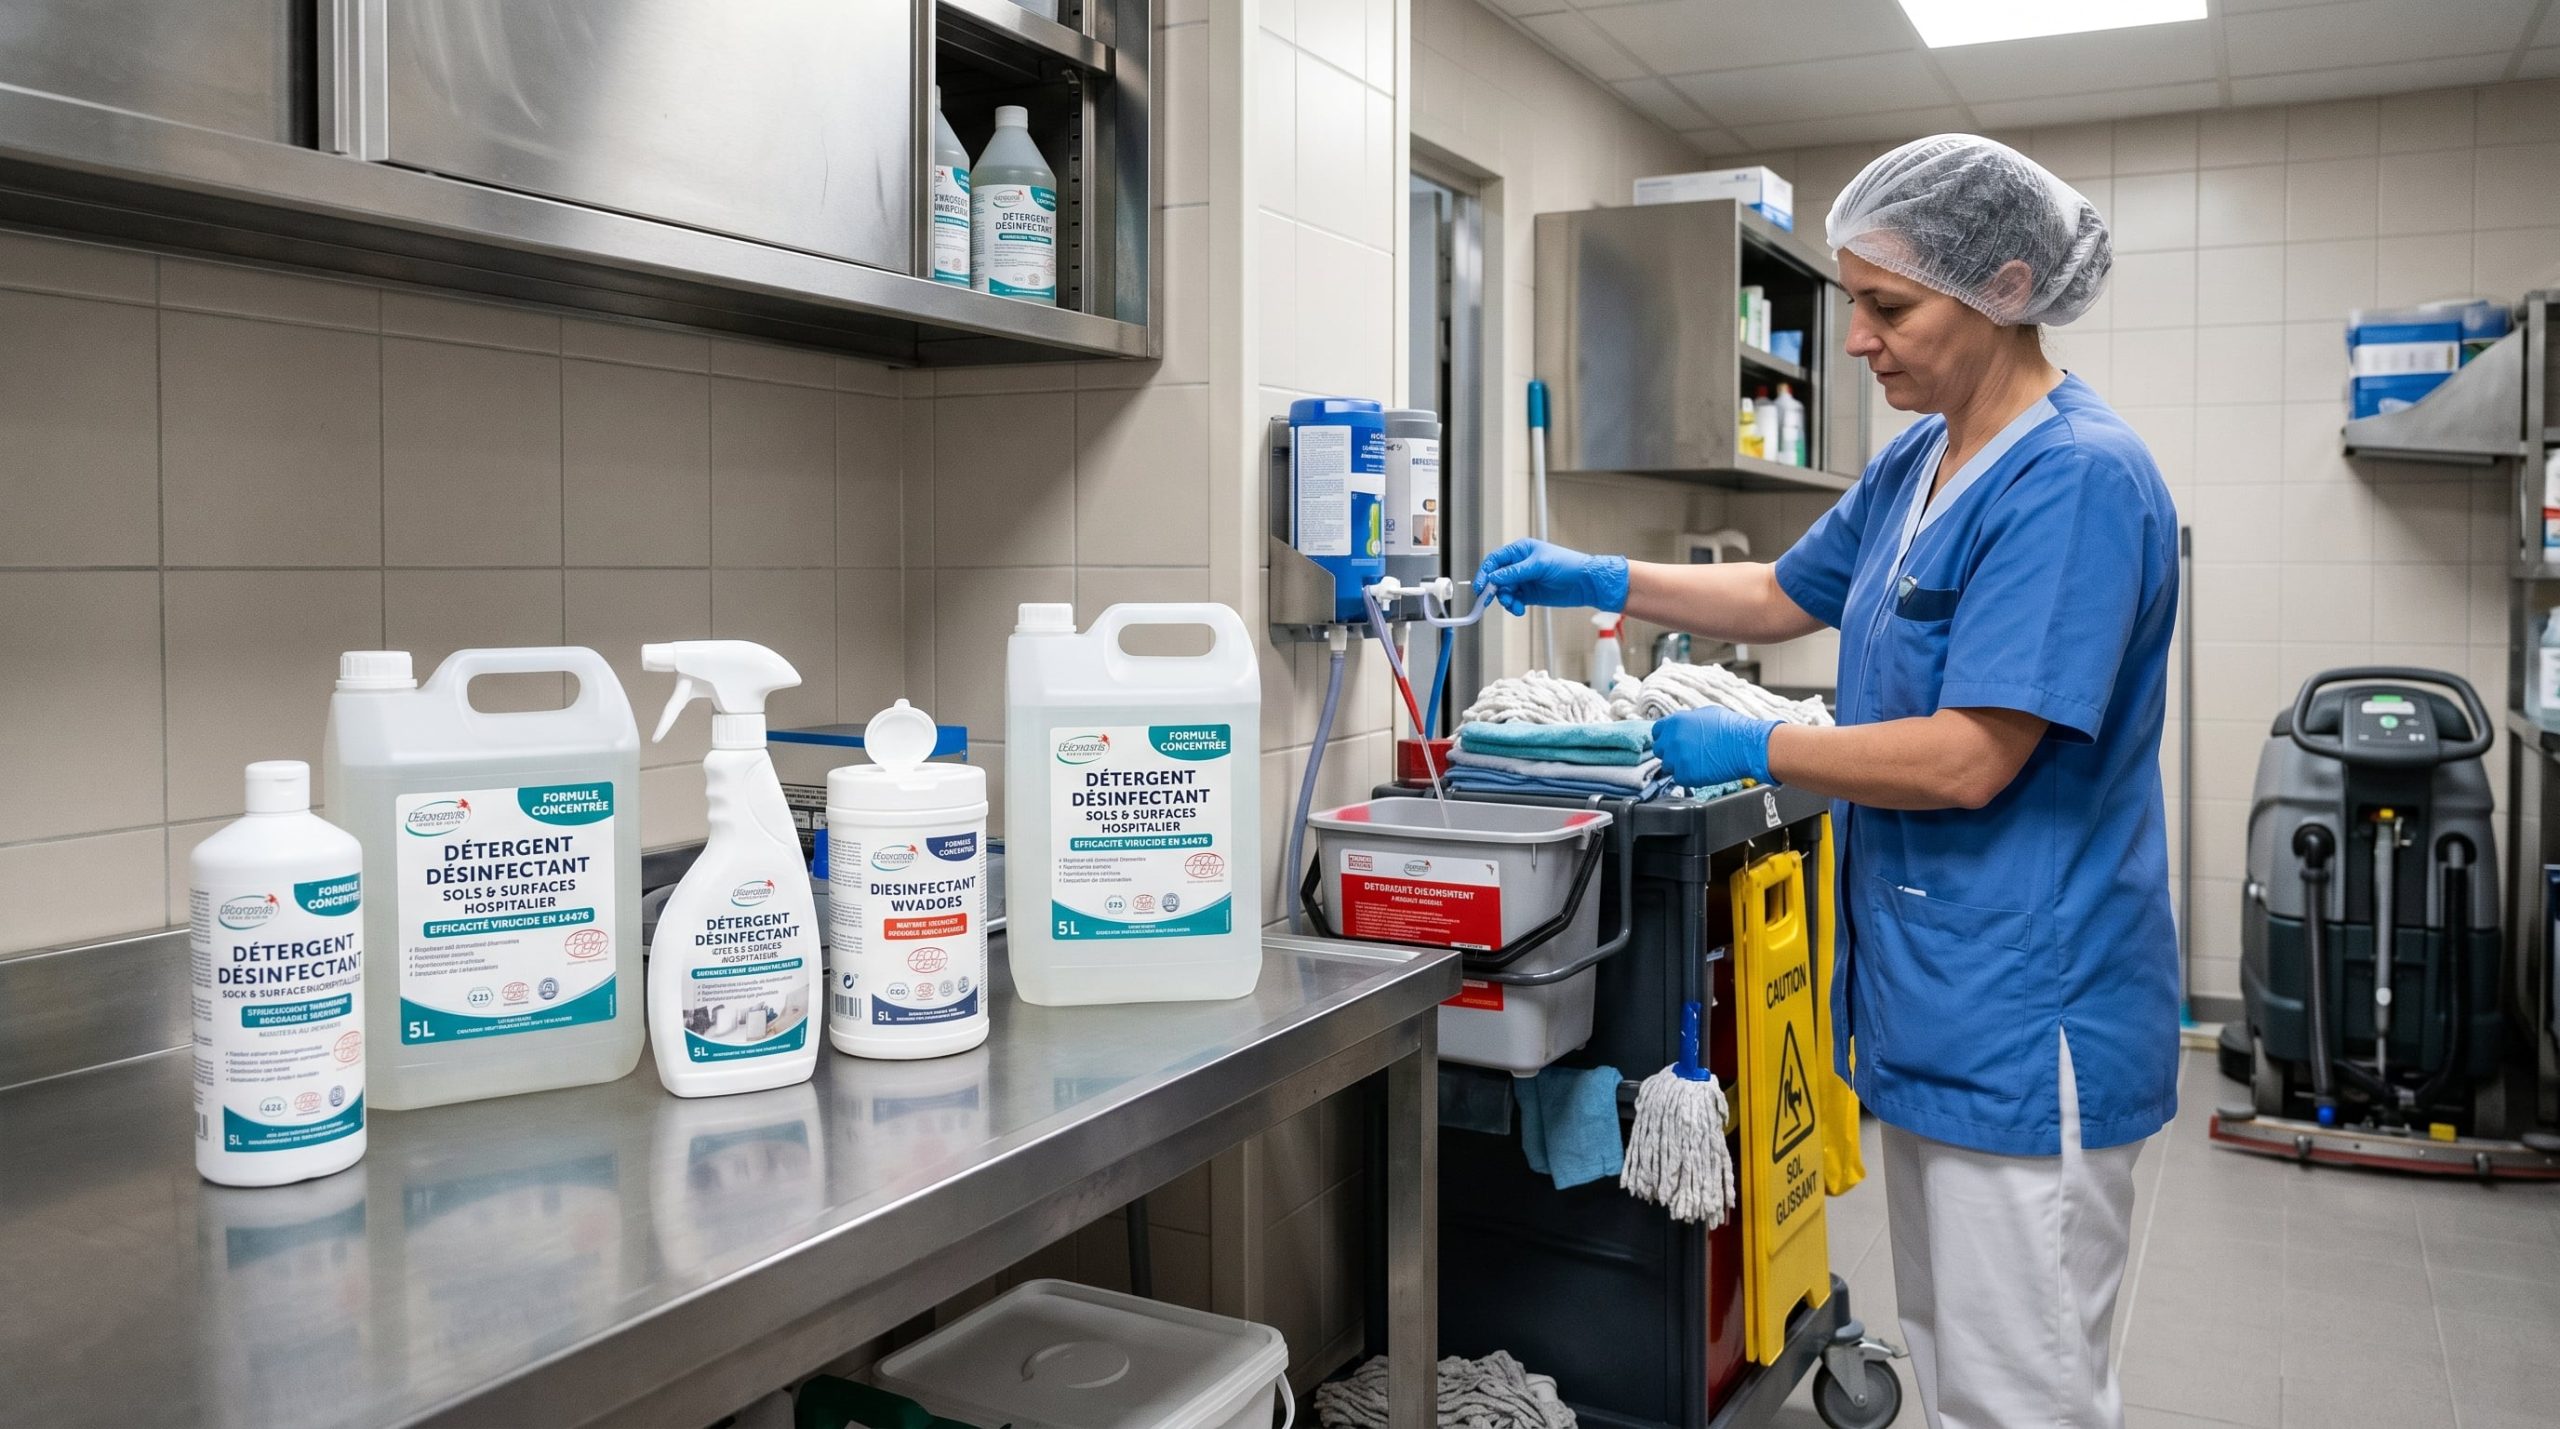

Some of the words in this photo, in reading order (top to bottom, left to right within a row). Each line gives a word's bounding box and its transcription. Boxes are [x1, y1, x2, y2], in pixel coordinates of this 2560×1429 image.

[1160, 739, 1227, 751] CONCENTRÉE
[1169, 731, 1217, 741] FORMULE
[1086, 768, 1196, 787] DÉTERGENT
[543, 790, 599, 803] FORMULE
[1072, 788, 1211, 807] DÉSINFECTANT
[531, 799, 609, 816] CONCENTRÉE
[1086, 810, 1118, 821] SOLS
[1121, 809, 1130, 820] &
[1133, 808, 1197, 820] SURFACES
[1101, 821, 1181, 833] HOSPITALIER
[444, 836, 573, 862] DÉTERGENT
[1124, 838, 1167, 847] VIRUCIDE
[1168, 837, 1180, 846] EN
[426, 856, 590, 885] DÉSINFECTANT
[443, 887, 482, 902] SOLS
[486, 886, 496, 898] &
[500, 879, 576, 897] SURFACES
[870, 876, 976, 896] DIESINFECTANT
[464, 896, 557, 915] HOSPITALIER
[430, 917, 490, 934] EFFICACITÉ
[491, 916, 541, 929] VIRUCIDE
[542, 914, 556, 924] EN
[707, 912, 790, 931] DÉTERGENT
[695, 925, 800, 946] DÉSINFECTANT
[233, 932, 354, 963] DÉTERGENT
[218, 951, 362, 985] DÉSINFECTANT
[222, 990, 247, 999] SOCK
[249, 990, 257, 998] &
[1766, 961, 1807, 1009] CAUTION
[408, 1020, 435, 1039] 5L
[1786, 1153, 1804, 1185] SOL
[1776, 1170, 1817, 1226] GLISSANT
